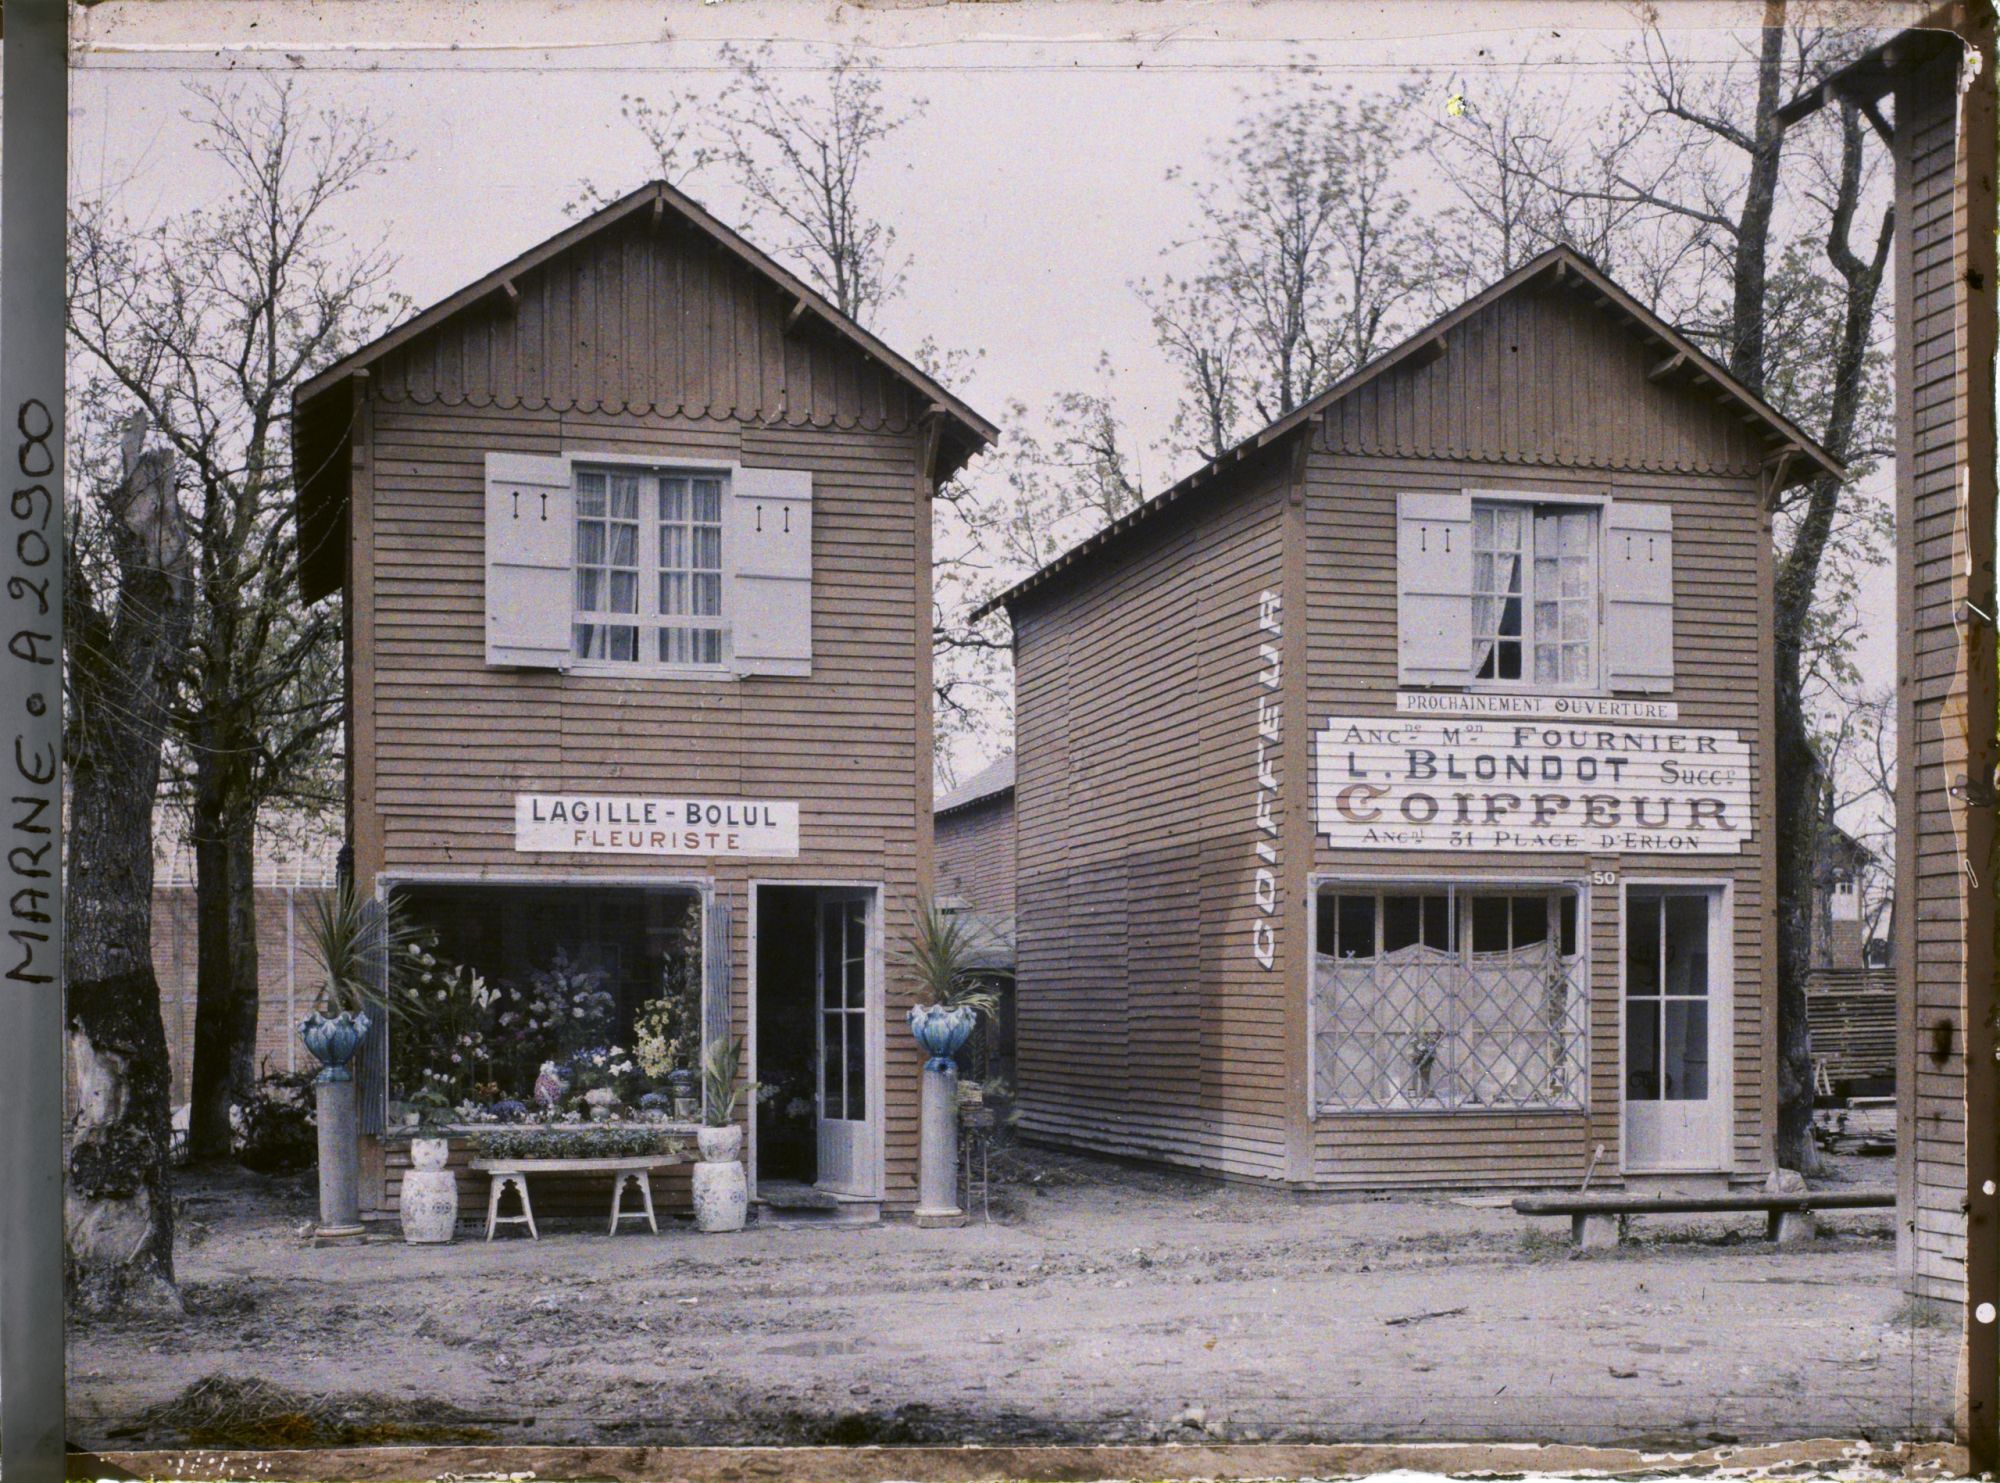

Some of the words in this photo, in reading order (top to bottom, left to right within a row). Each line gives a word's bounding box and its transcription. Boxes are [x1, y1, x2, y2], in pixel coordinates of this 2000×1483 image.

[1407, 695, 1542, 713] PROCHAINEMENT
[1554, 699, 1668, 718] OUVERTURE
[1512, 726, 1719, 754] FOURNIER
[1404, 749, 1629, 782] BLONDOT
[1253, 590, 1282, 972] COIFFEUR
[1336, 783, 1738, 831] COIFFEUR
[574, 830, 740, 850] FLEURISTE
[1449, 831, 1474, 847] 31
[1494, 831, 1578, 848] PLACE
[6, 735, 55, 985] MARNE
[1594, 872, 1616, 885] 50
